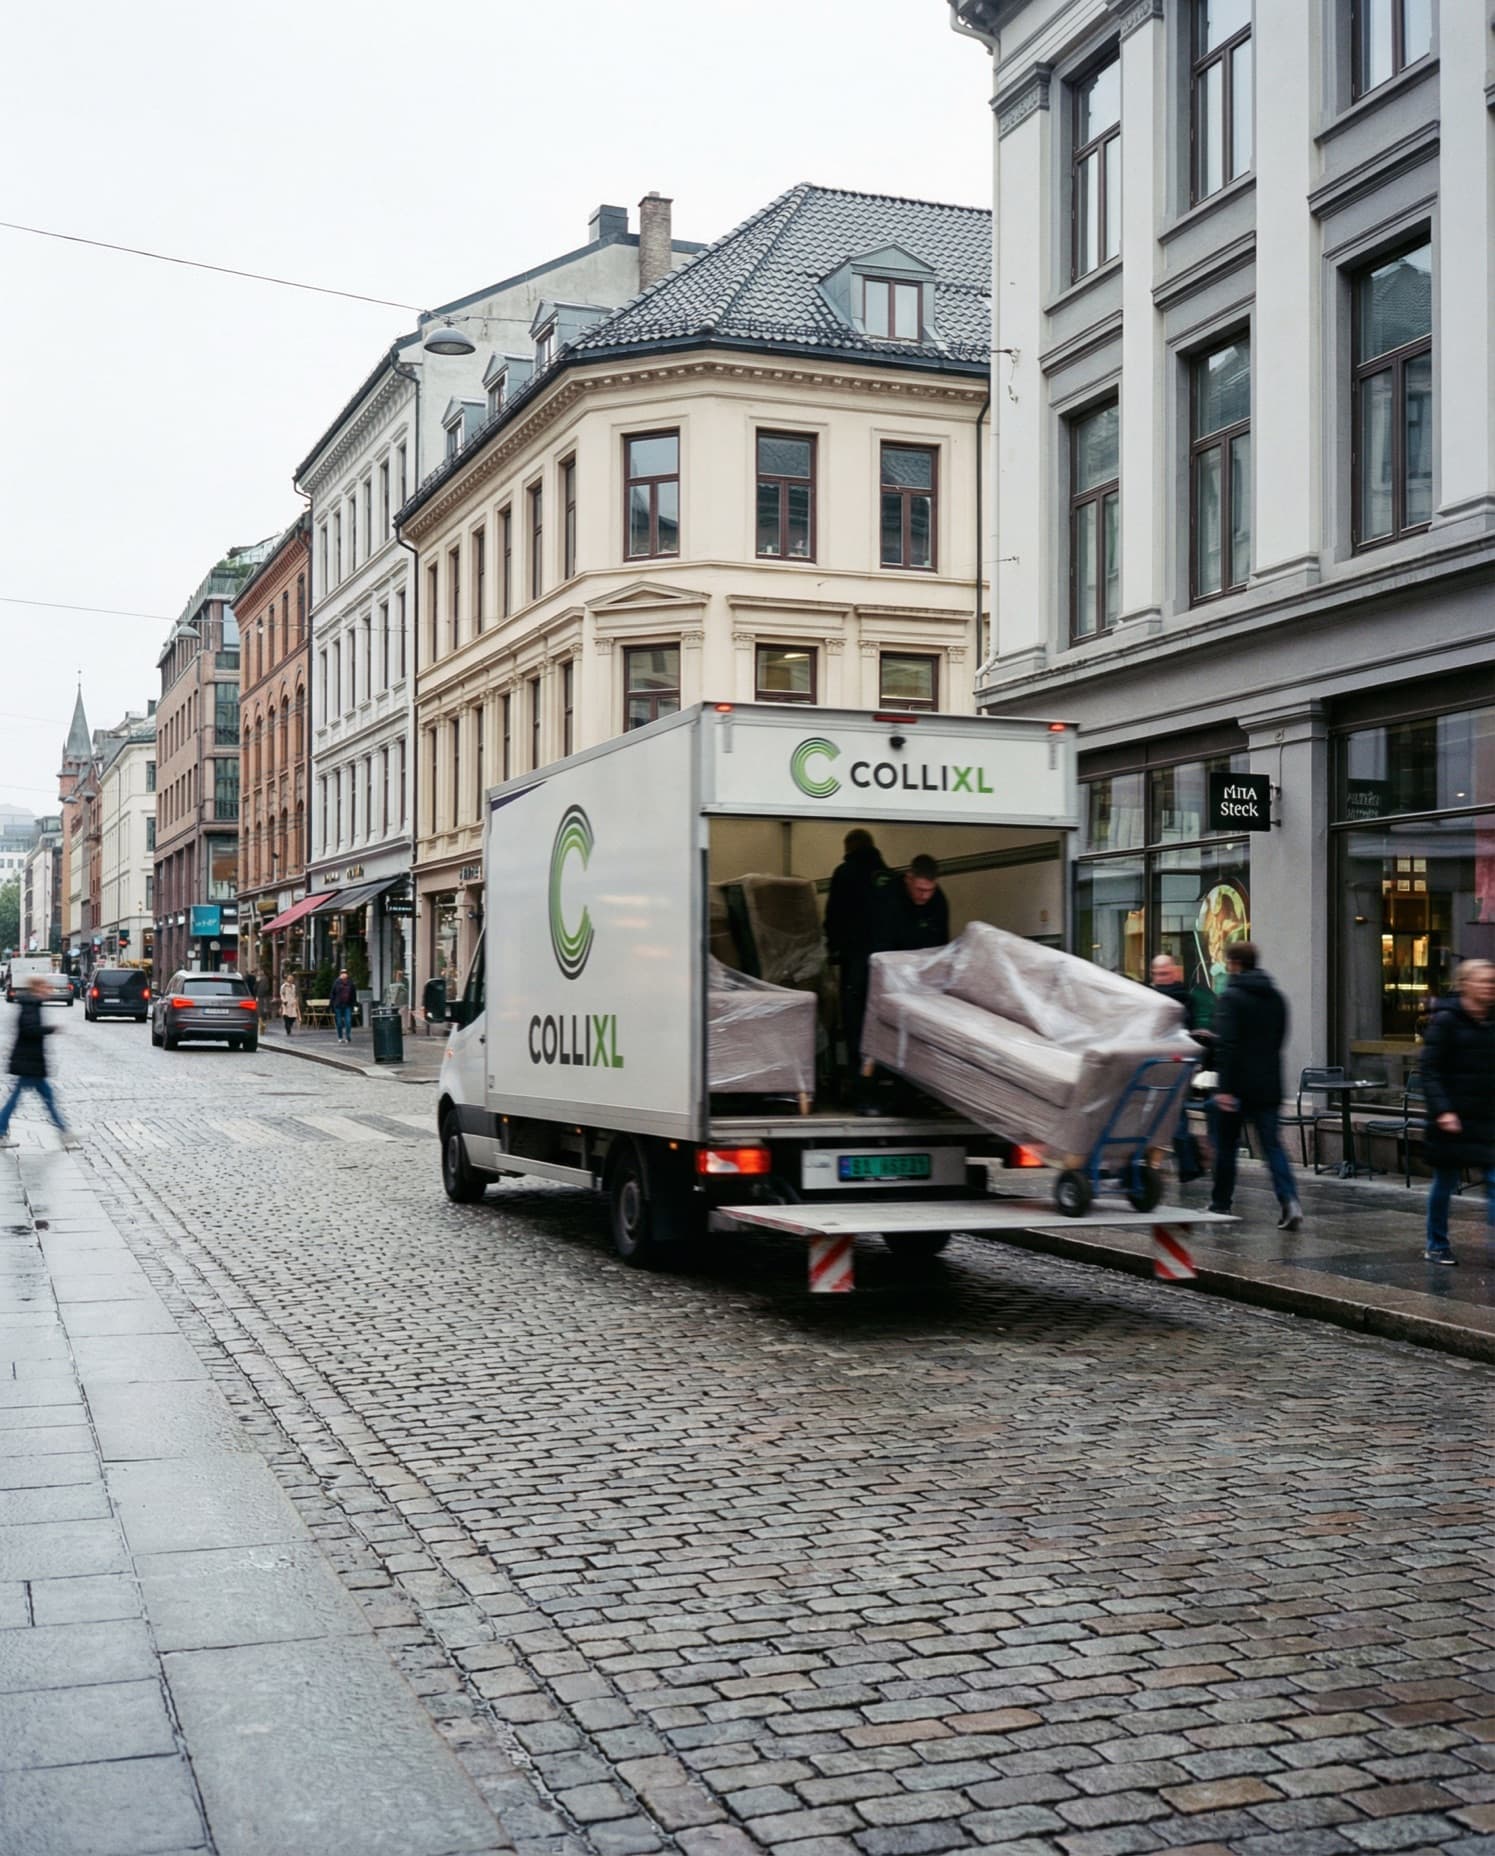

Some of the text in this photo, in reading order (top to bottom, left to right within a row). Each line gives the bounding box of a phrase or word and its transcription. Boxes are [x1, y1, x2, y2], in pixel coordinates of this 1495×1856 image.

[850, 761, 994, 794] COLLIXL
[1220, 802, 1259, 817] Steck
[529, 1014, 624, 1068] COLLIXL
